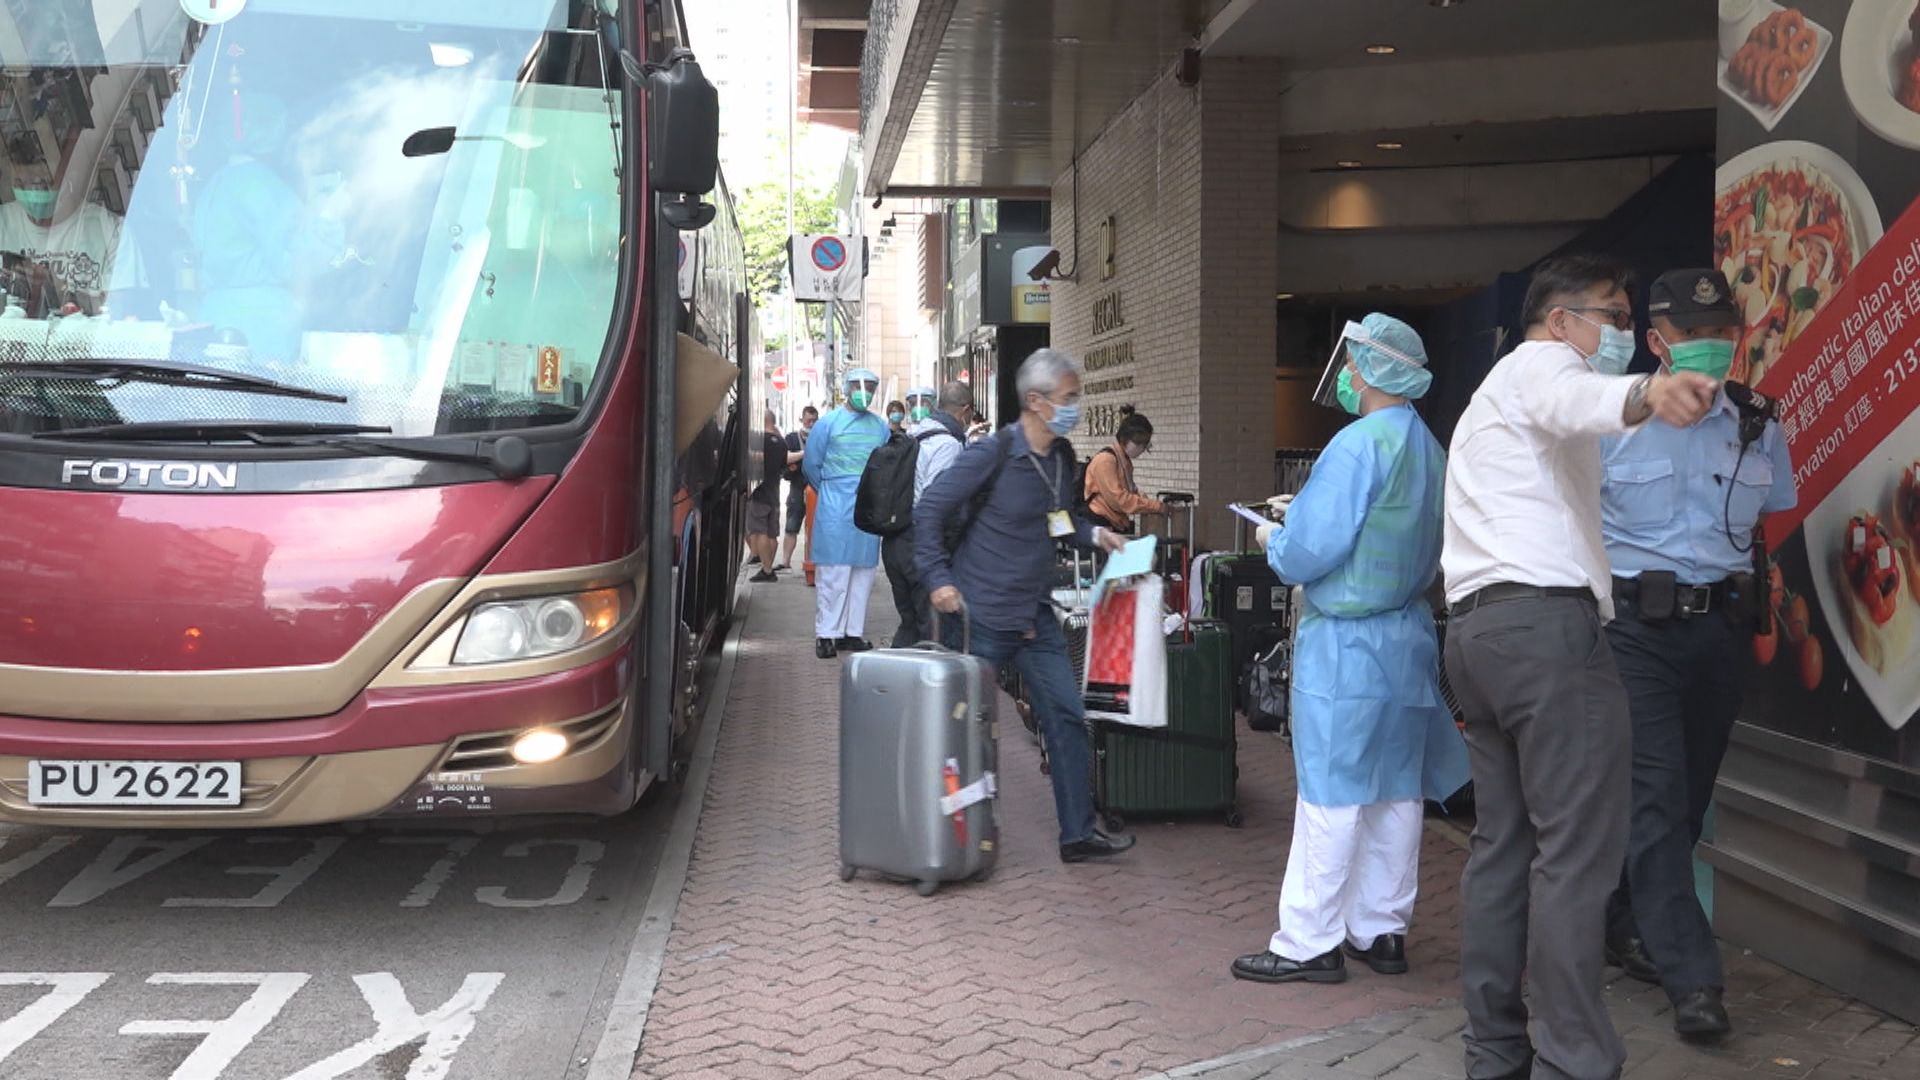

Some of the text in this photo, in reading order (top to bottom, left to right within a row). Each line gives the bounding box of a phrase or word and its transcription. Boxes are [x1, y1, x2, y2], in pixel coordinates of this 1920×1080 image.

[1779, 332, 1843, 417] authentic
[1841, 281, 1892, 343] Italian
[61, 459, 238, 489] FOTON
[41, 764, 230, 799] PU 2622
